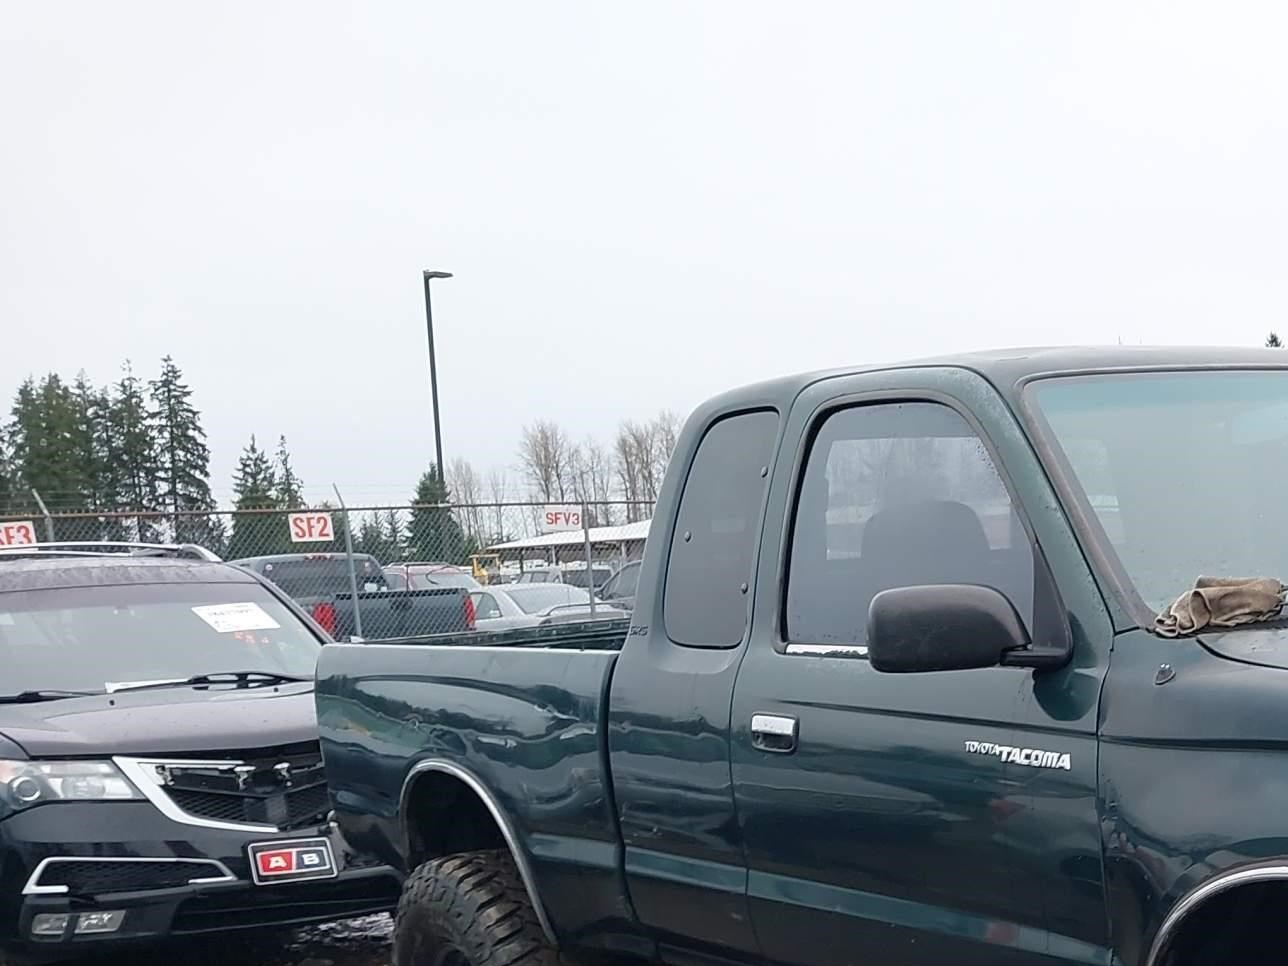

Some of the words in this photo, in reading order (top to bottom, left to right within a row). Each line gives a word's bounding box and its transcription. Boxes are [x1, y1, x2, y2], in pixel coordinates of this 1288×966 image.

[292, 516, 330, 538] SF2
[546, 511, 580, 526] SFV3
[964, 740, 1000, 756] TOYOTA
[999, 746, 1072, 771] TACOMA
